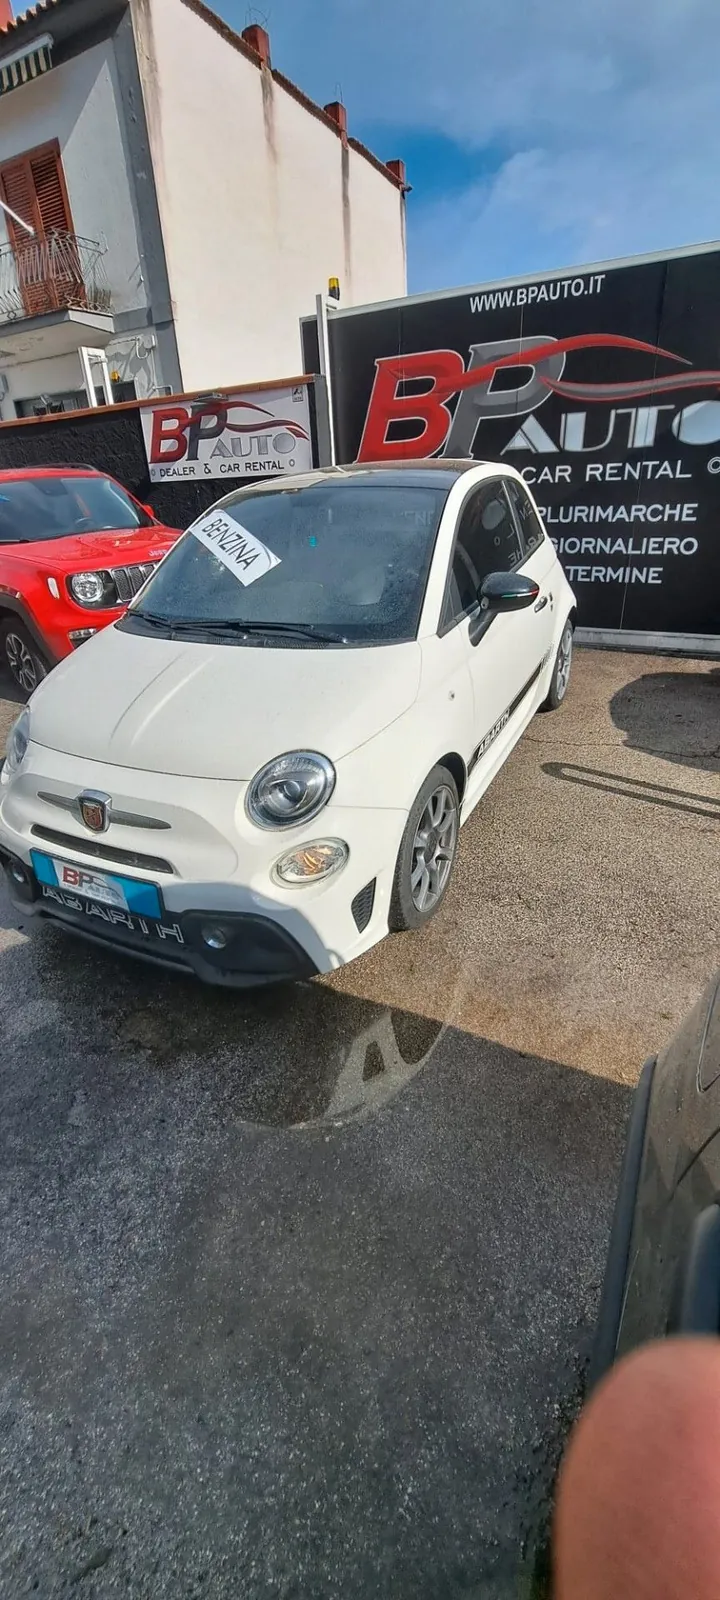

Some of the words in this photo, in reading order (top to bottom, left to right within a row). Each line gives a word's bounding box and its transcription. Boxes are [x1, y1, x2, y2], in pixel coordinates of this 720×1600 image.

[469, 274, 606, 313] WWW.BPAUTO.IT
[149, 400, 228, 464] BP
[210, 432, 296, 459] AUTO
[159, 466, 196, 477] DEALER
[203, 463, 212, 474] &
[219, 463, 241, 473] CAR
[244, 461, 285, 471] RENTAL
[520, 464, 572, 484] CAR
[585, 459, 692, 482] RENTAL
[201, 518, 262, 571] BENZINA
[565, 565, 664, 584] TERMINE
[62, 865, 94, 887] BP
